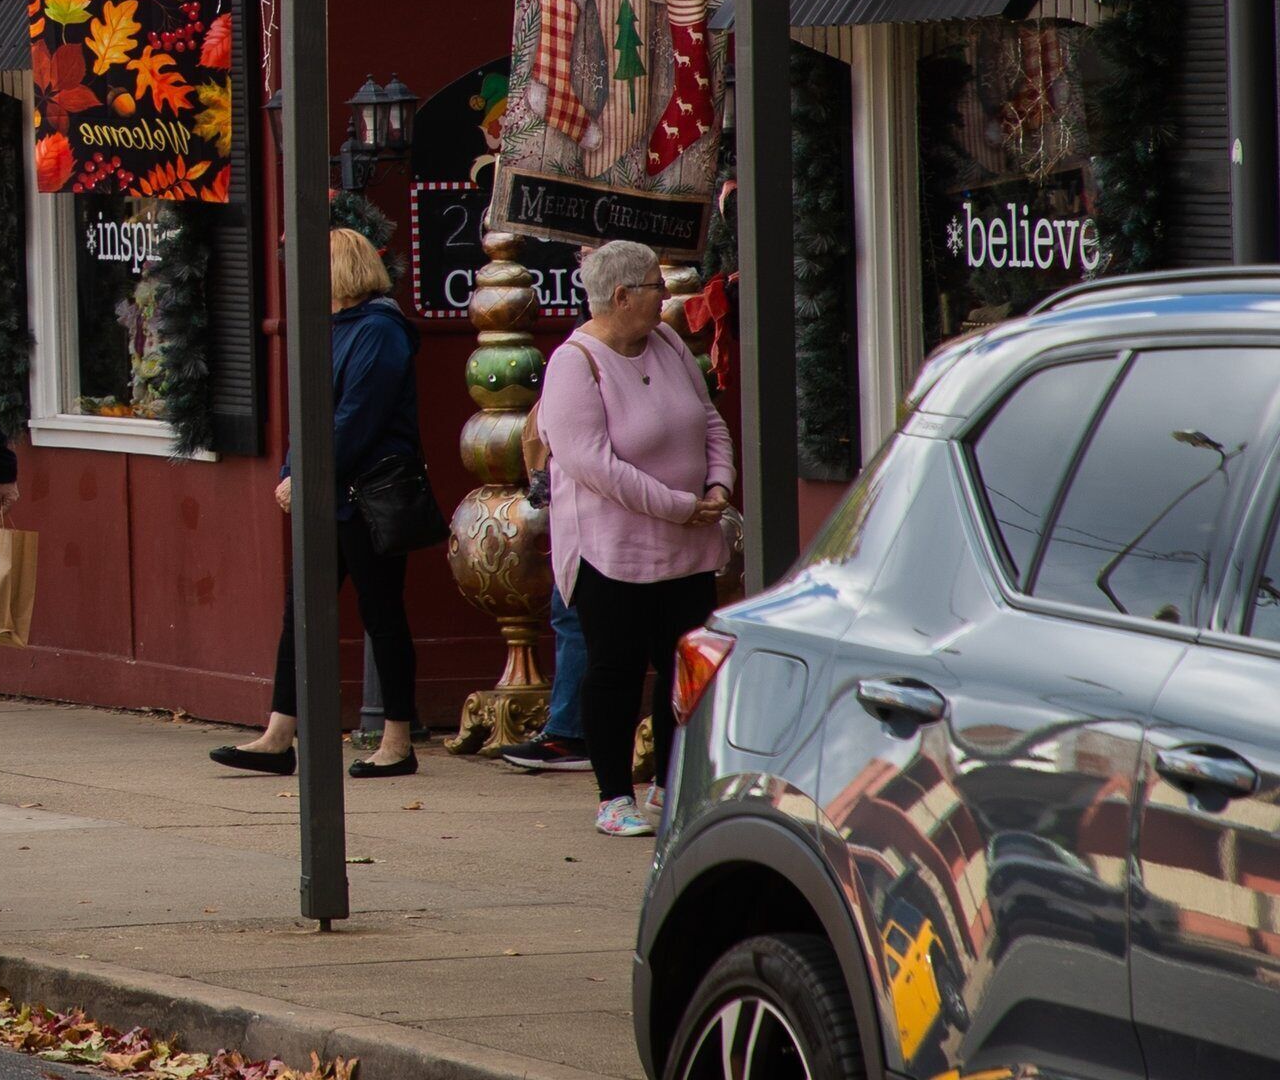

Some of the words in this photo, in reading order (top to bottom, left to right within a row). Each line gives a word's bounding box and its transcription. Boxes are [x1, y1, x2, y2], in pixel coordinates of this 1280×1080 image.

[96, 211, 162, 274] inspi
[518, 184, 589, 224] MERRY
[593, 195, 697, 240] CHRISTMAS
[962, 202, 1101, 270] believe
